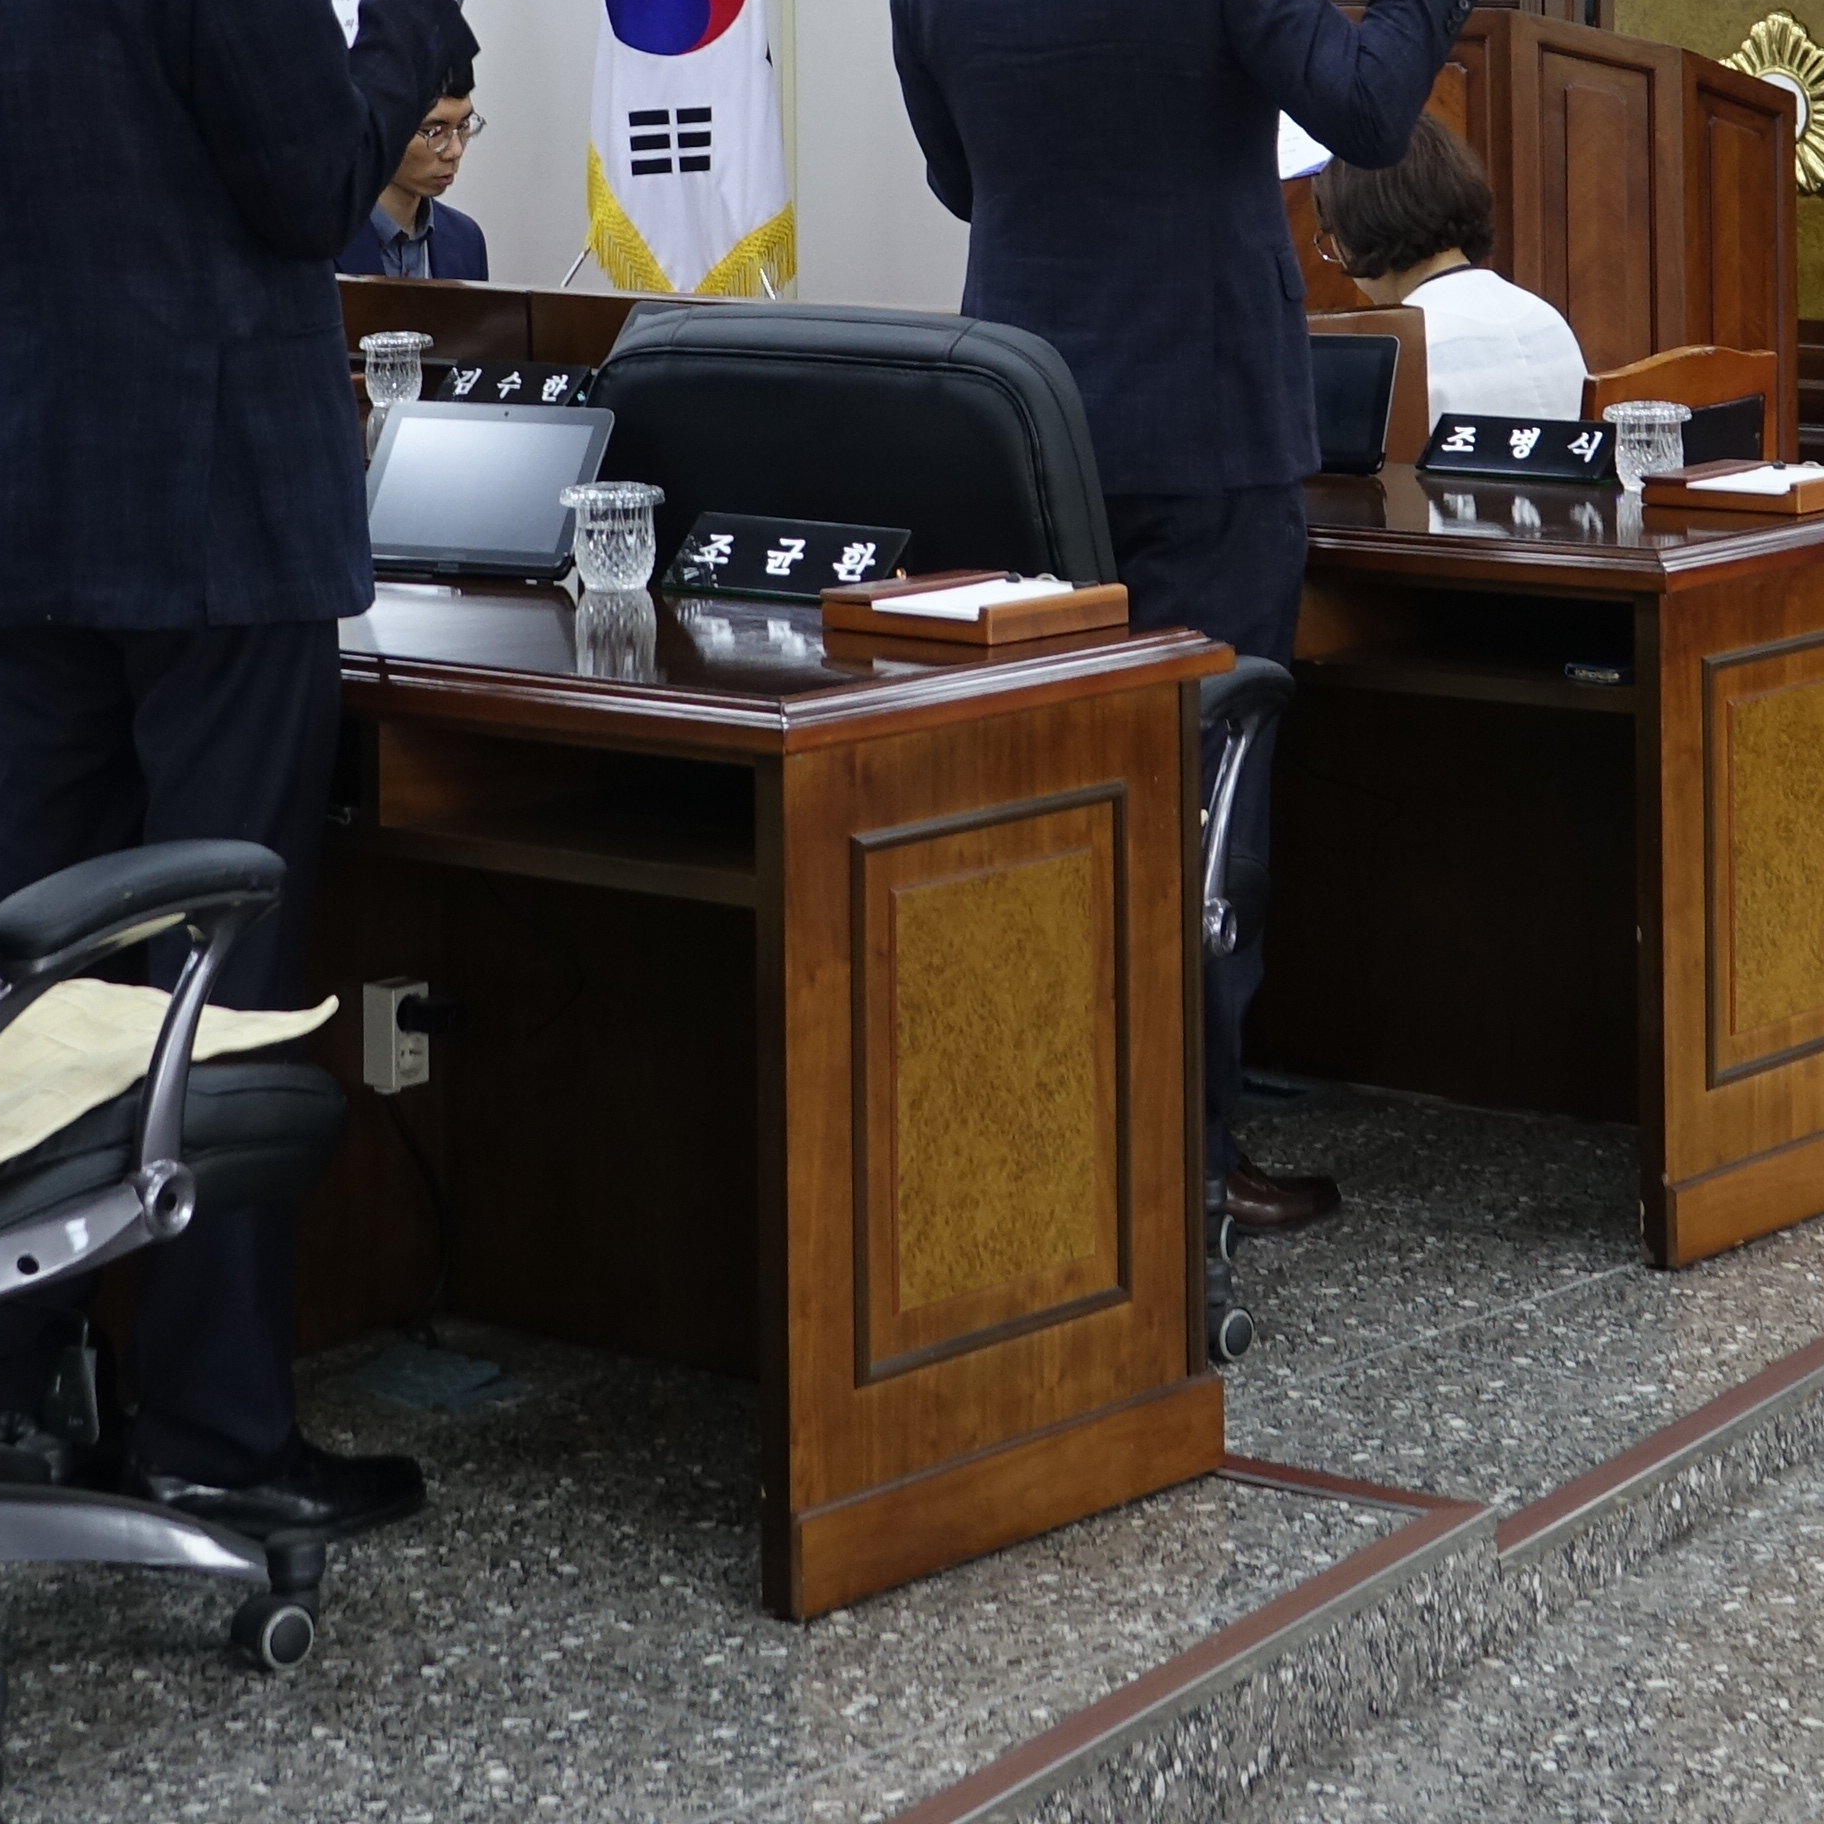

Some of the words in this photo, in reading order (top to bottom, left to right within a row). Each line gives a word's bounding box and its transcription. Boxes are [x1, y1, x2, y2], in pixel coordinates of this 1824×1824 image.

[452, 367, 569, 402] 김수한
[1440, 425, 1603, 464] 조병식
[692, 533, 876, 582] 조균환
